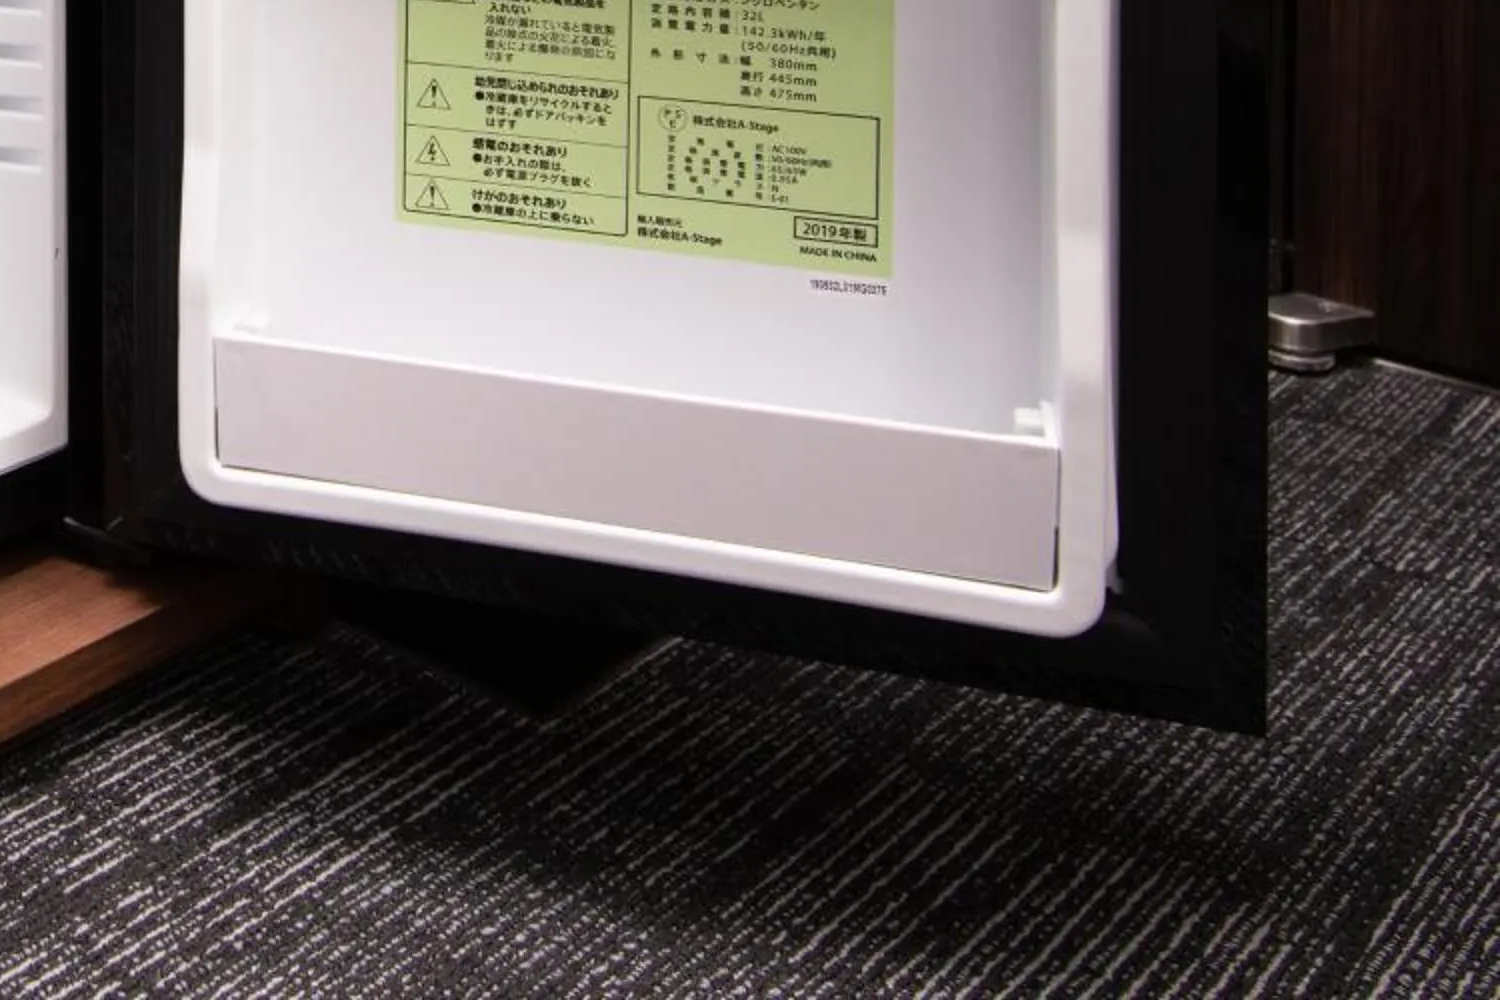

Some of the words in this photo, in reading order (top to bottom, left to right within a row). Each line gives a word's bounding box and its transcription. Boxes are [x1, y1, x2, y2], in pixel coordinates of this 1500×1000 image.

[802, 221, 868, 242] 2019年製
[800, 245, 829, 258] MADE
[832, 247, 843, 259] IN
[844, 249, 877, 263] CHINA
